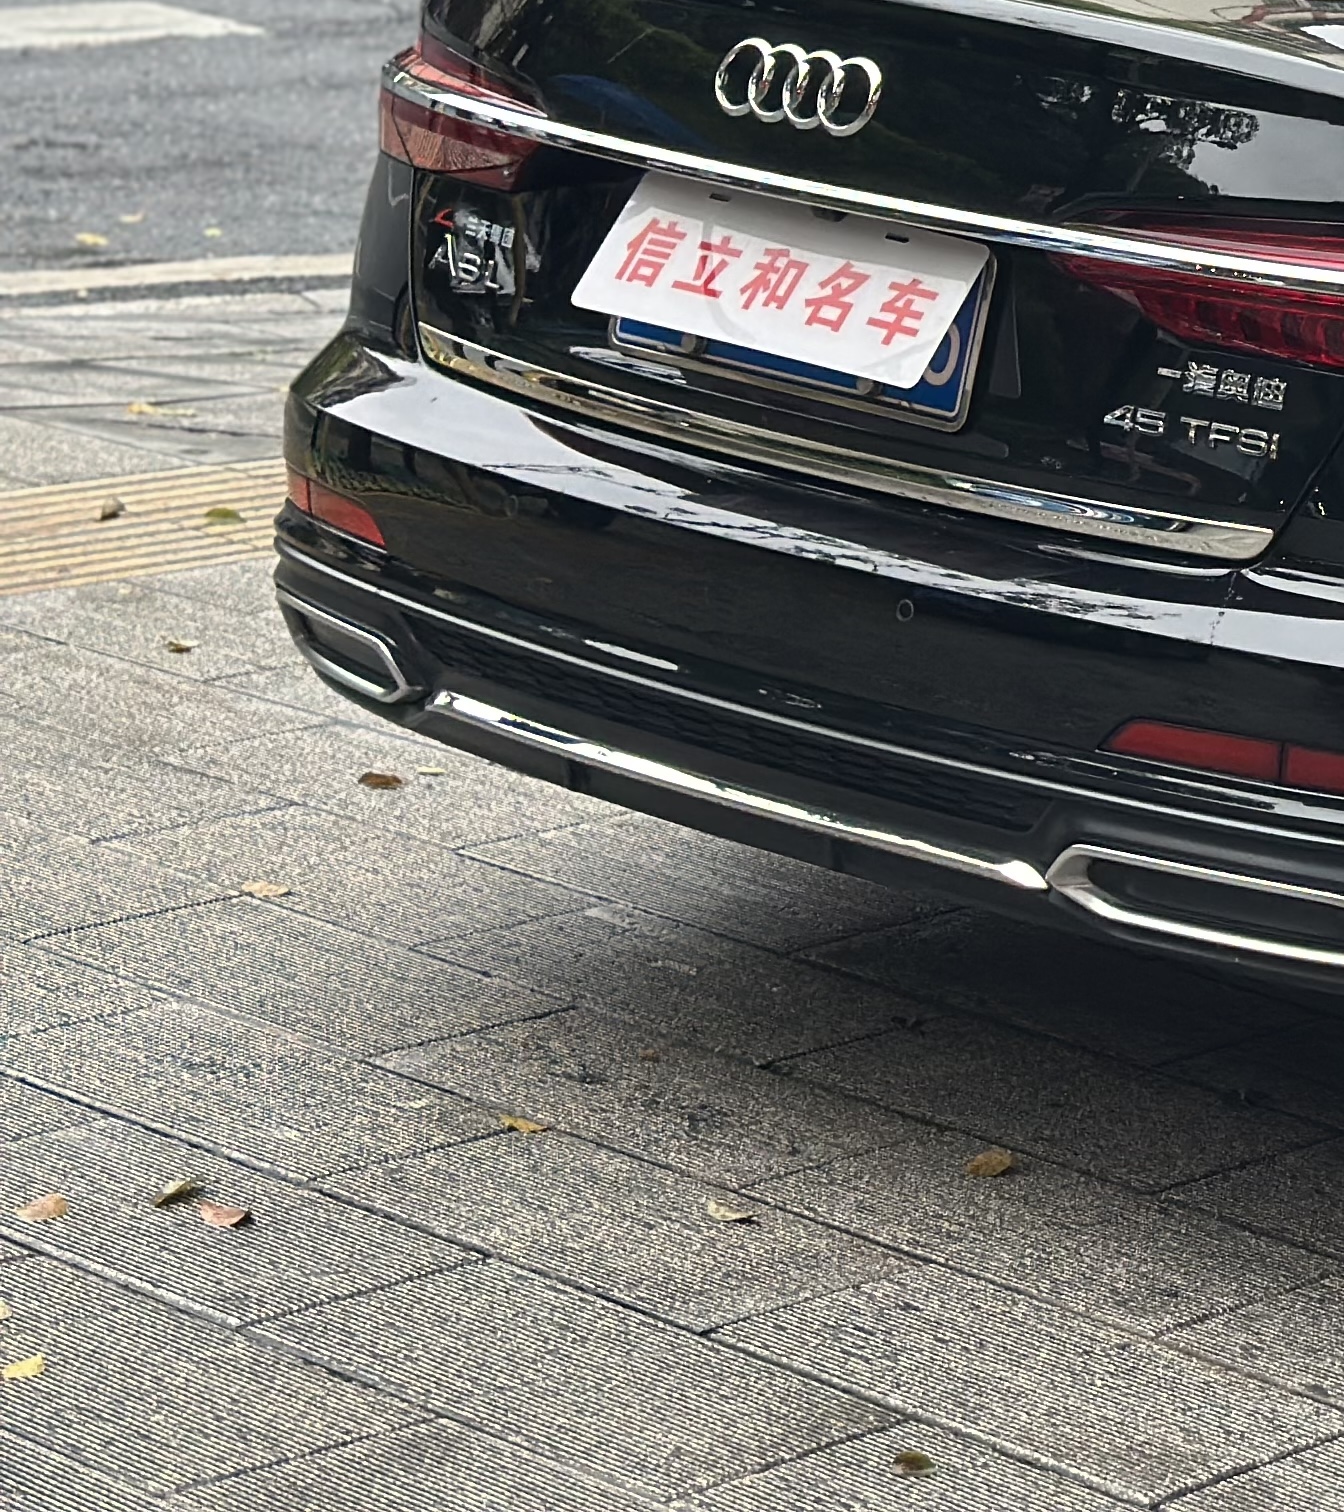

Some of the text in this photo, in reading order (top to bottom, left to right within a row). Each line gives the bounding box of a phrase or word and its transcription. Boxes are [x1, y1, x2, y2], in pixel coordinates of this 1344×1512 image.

[614, 216, 940, 347] 信立和名车
[1156, 360, 1288, 412] 一汽奥迪
[1103, 404, 1281, 461] 45 TFSI
